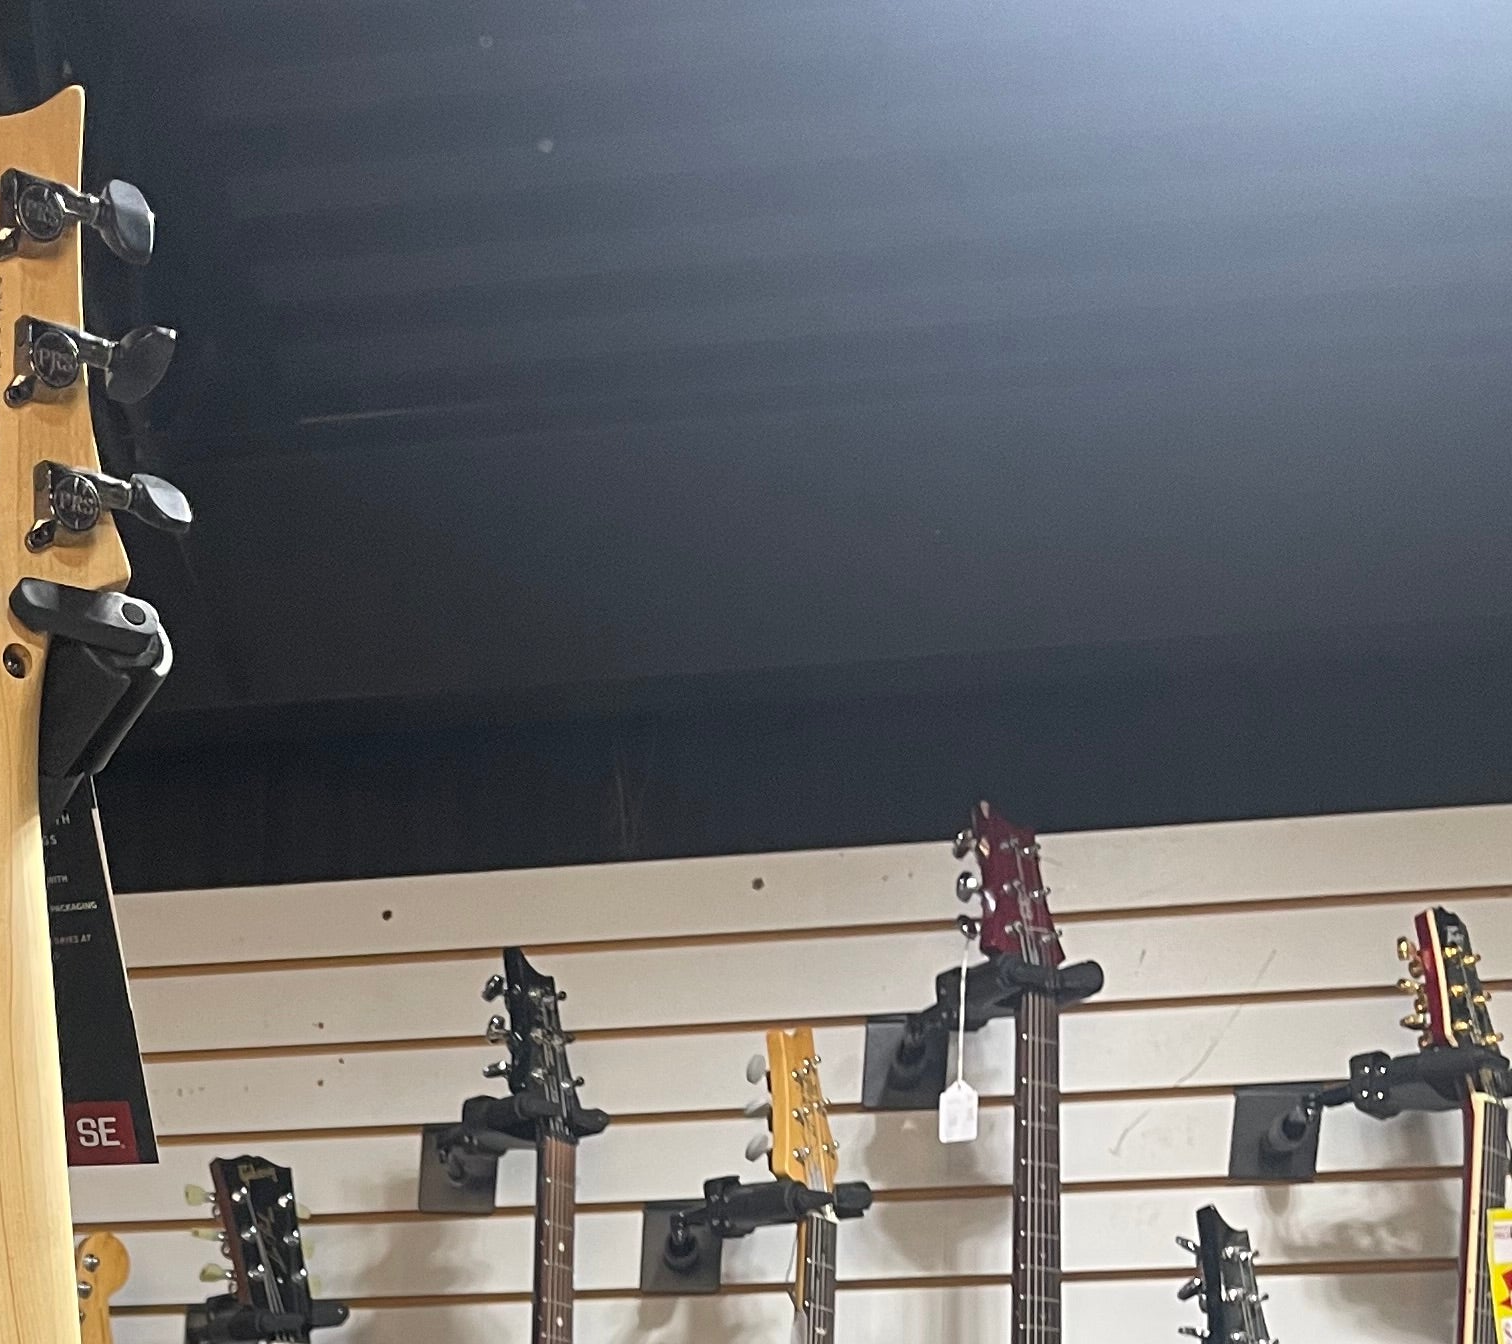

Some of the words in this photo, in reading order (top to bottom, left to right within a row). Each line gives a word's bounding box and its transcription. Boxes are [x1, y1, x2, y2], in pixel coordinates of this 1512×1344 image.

[39, 348, 77, 374] PRS
[59, 491, 95, 514] PRS
[76, 1117, 121, 1147] SE
